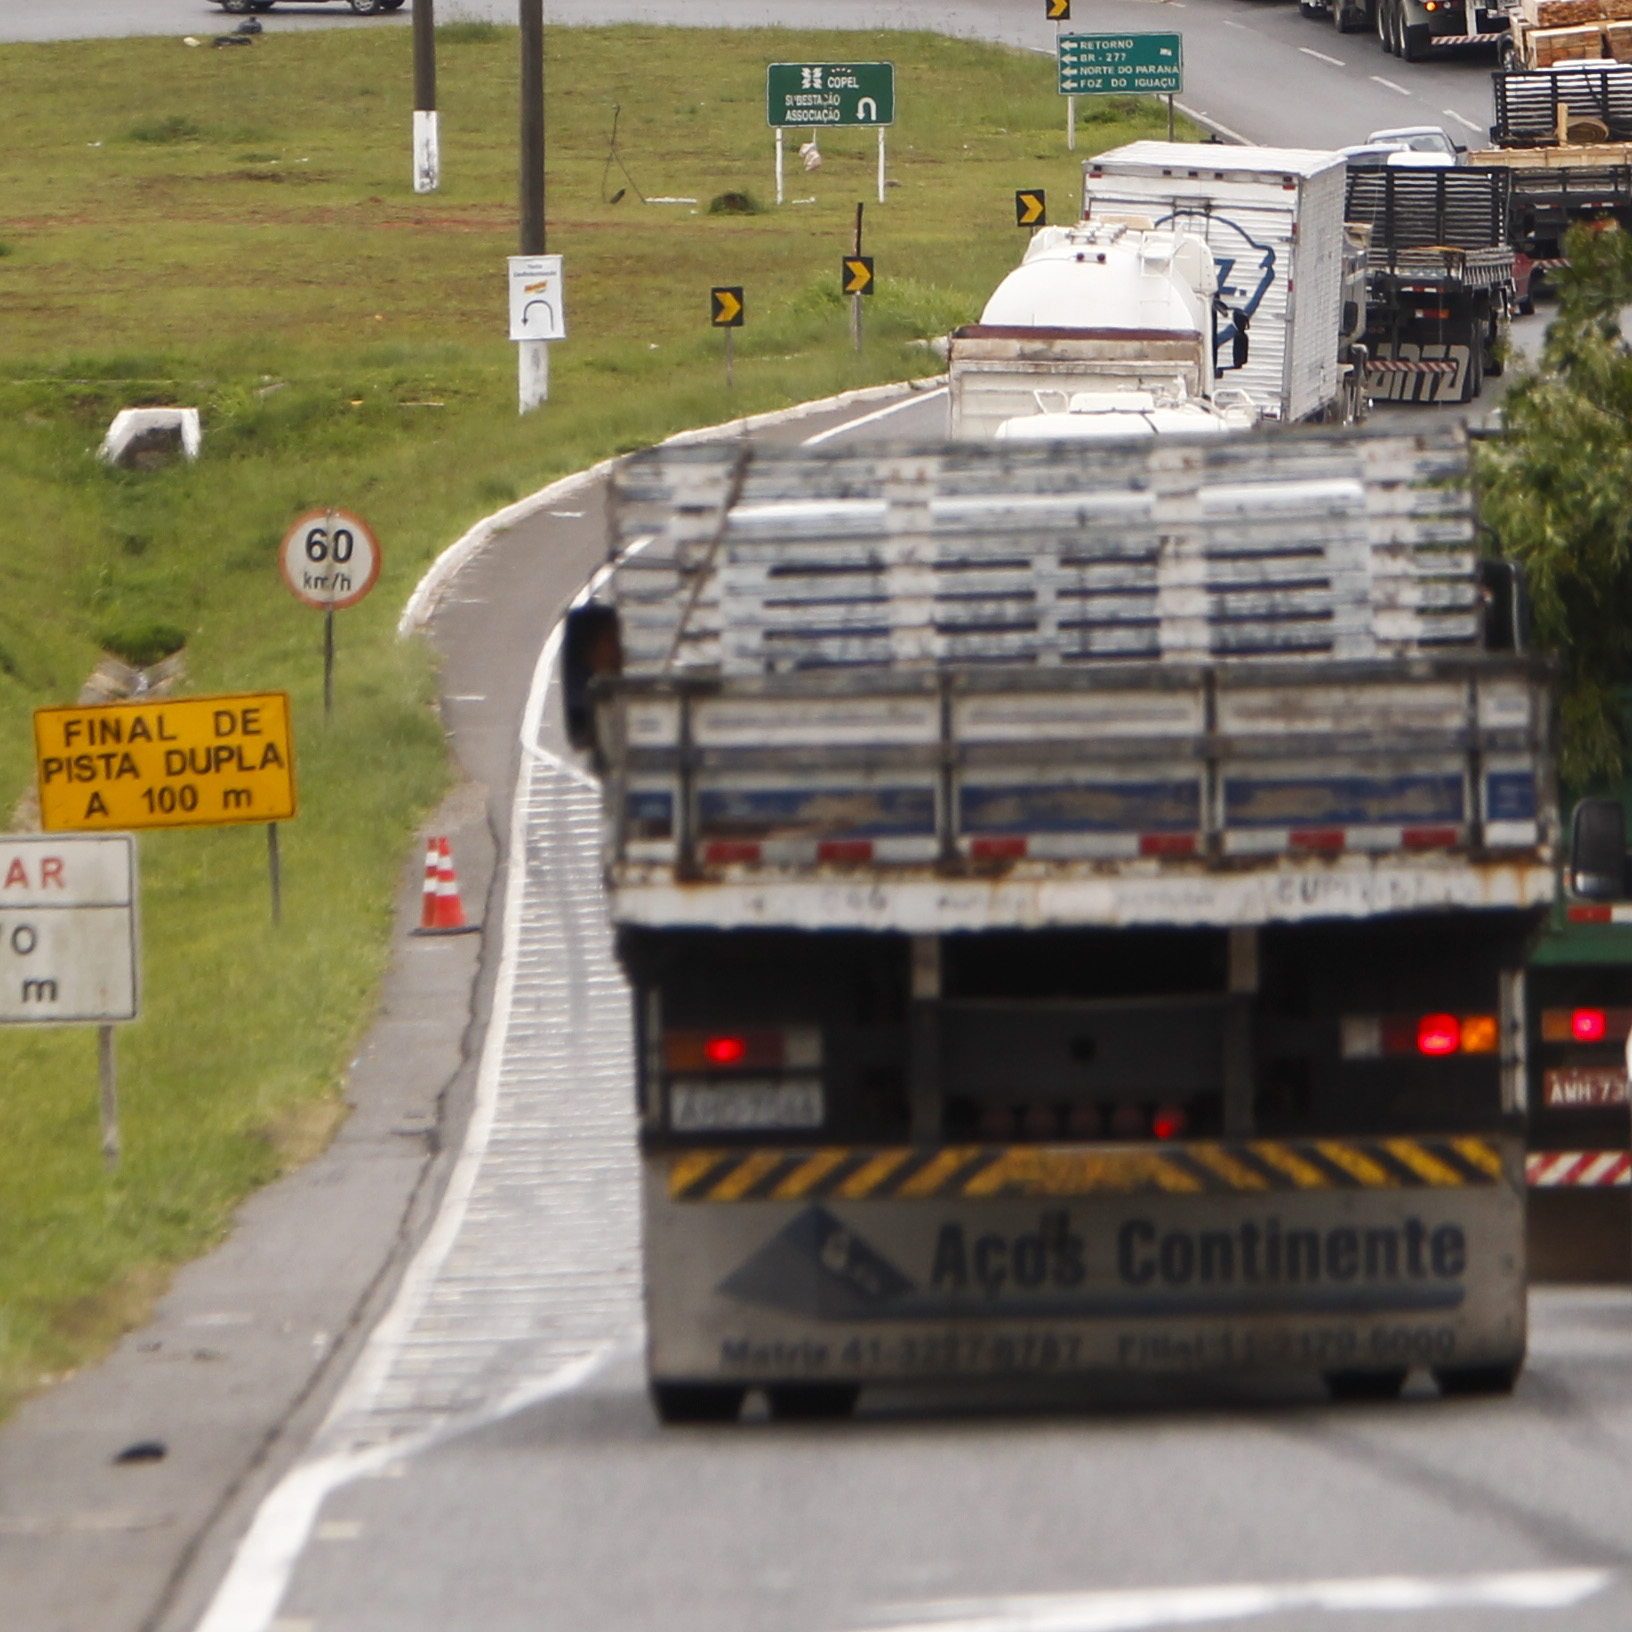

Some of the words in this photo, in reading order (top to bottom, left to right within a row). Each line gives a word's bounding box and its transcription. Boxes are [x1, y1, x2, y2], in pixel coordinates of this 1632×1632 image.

[1080, 39, 1134, 50] RETORNO
[1080, 67, 1115, 75] NORTE
[1118, 65, 1133, 74] DO
[1136, 62, 1179, 74] PARANÁ
[827, 76, 859, 88] COPEL
[1080, 79, 1103, 88] FOZ
[1111, 78, 1127, 88] DO
[1135, 78, 1176, 88] IGUAÇU
[785, 107, 841, 123] ASSOCIAÇÃO
[305, 528, 354, 564] 60
[303, 572, 351, 591] km/h
[64, 715, 177, 748] FINAL
[213, 708, 263, 738] DE
[42, 751, 141, 784] PISTA
[164, 741, 285, 778] DUPLA
[84, 791, 109, 820] A
[141, 784, 199, 815] 100
[222, 787, 253, 810] m
[20, 976, 59, 1003] m
[930, 1221, 1087, 1302] Aços
[1118, 1213, 1467, 1287] Continente
